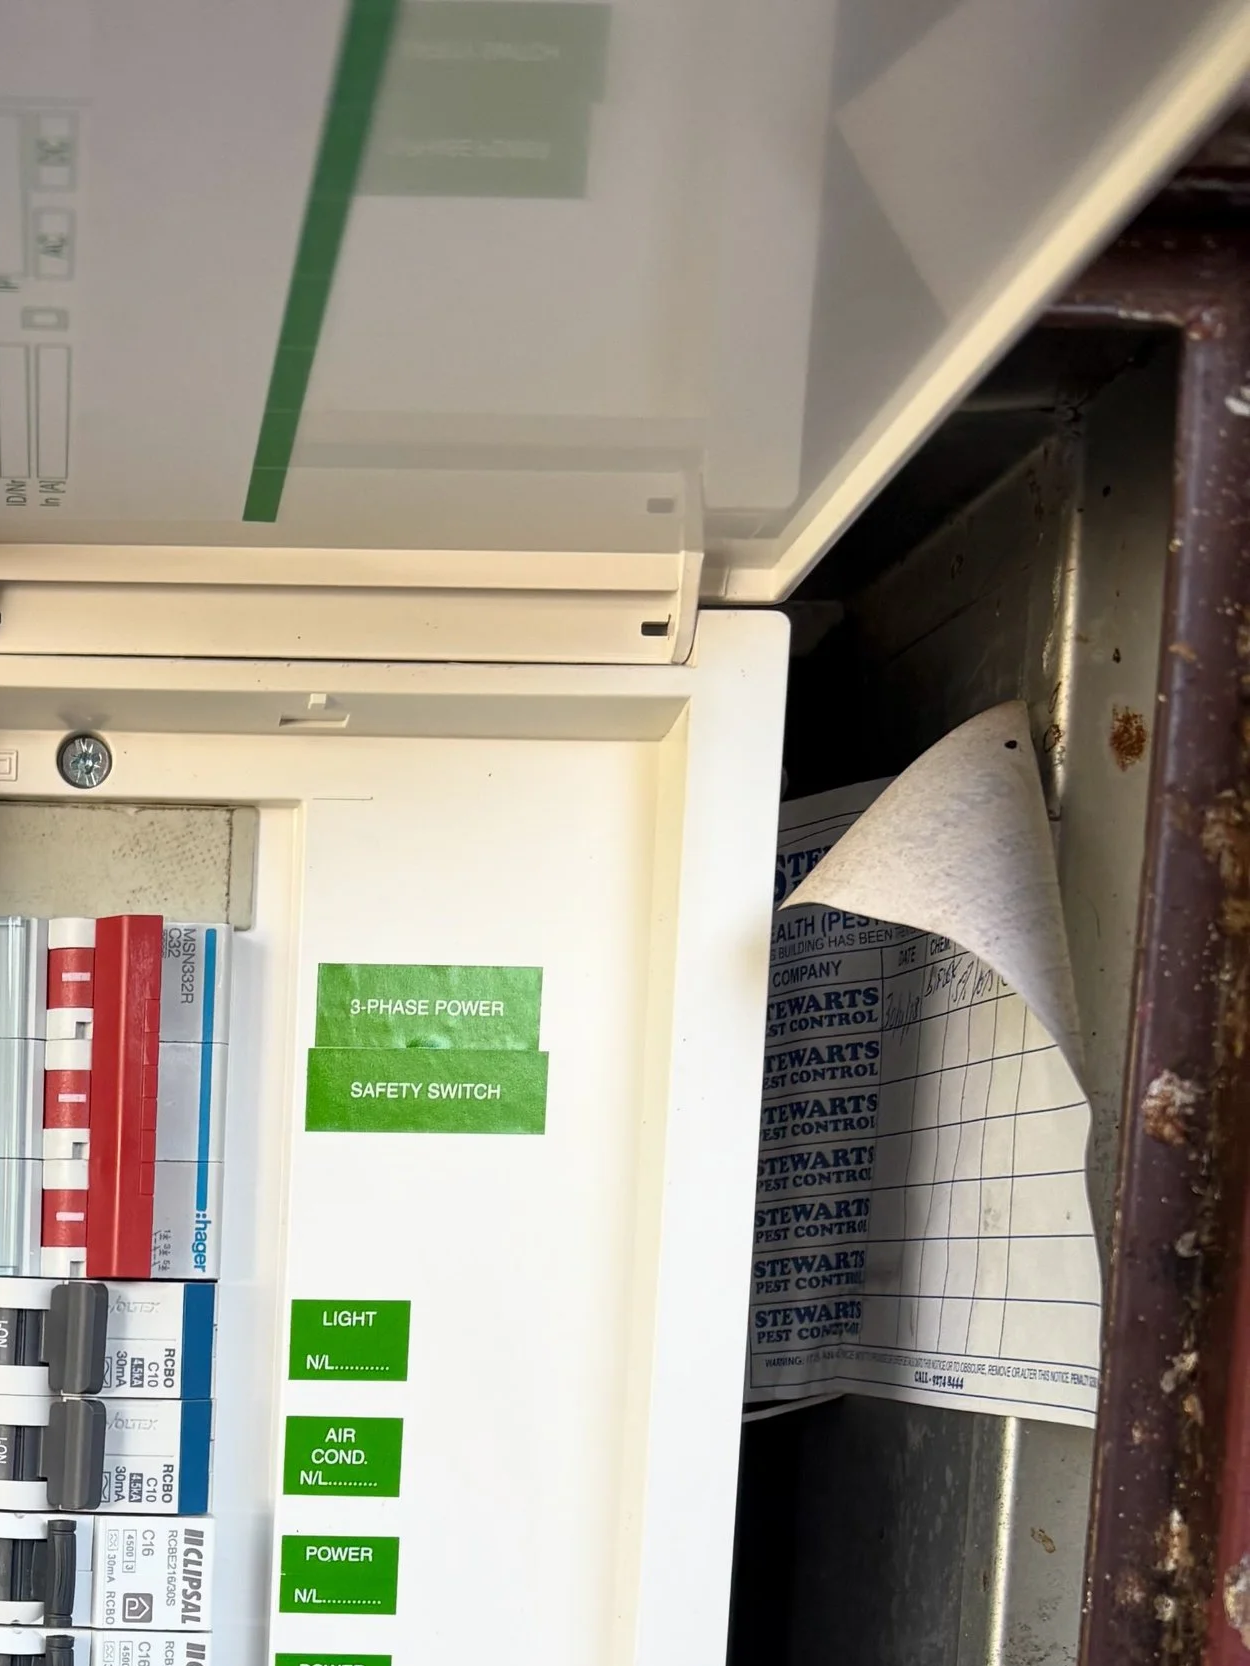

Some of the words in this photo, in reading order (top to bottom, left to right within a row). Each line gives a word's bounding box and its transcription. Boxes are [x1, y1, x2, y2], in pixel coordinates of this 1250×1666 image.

[6, 480, 27, 507] ID/Nr
[40, 480, 65, 493] [A]
[167, 928, 181, 958] C32
[779, 938, 824, 959] BUILDING
[828, 935, 855, 948] HAS
[859, 929, 893, 944] BEEN
[181, 928, 196, 1004] MSN332R
[773, 960, 841, 987] COMPANY
[350, 999, 429, 1016] 3-PHASE
[435, 1000, 504, 1017] POWER
[766, 987, 879, 1021] TEWARTS
[790, 1010, 878, 1033] CONTROL
[764, 1041, 879, 1073] TEWARTS
[763, 1076, 787, 1090] EST
[790, 1063, 878, 1085] CONTROL
[350, 1082, 423, 1098] SAFETY
[427, 1083, 501, 1100] SWITCH
[761, 1094, 877, 1125] TEWARTS
[755, 1198, 870, 1227] STEWARTS
[756, 1228, 790, 1244] PEST
[754, 1250, 865, 1278] STEWARTS
[756, 1279, 791, 1294] PEST
[322, 1311, 377, 1327] LIGHT
[757, 1329, 792, 1344] PEST
[115, 1350, 128, 1387] 30mA
[130, 1358, 143, 1387] 4.5kA
[146, 1362, 158, 1387] C10
[162, 1347, 176, 1388] RCBO
[325, 1428, 356, 1443] AIR
[311, 1449, 368, 1465] COND.
[114, 1465, 126, 1502] 30mA
[130, 1473, 142, 1503] 4.5kA
[145, 1477, 157, 1503] C10
[161, 1464, 174, 1504] RCBO
[126, 1534, 134, 1558] 4500
[142, 1529, 154, 1556] C16
[306, 1546, 373, 1562] POWER
[106, 1554, 117, 1583] 30mA
[166, 1530, 178, 1607] RCBE216/30S
[181, 1548, 203, 1624] CLIPSAL
[105, 1591, 116, 1625] RCBO
